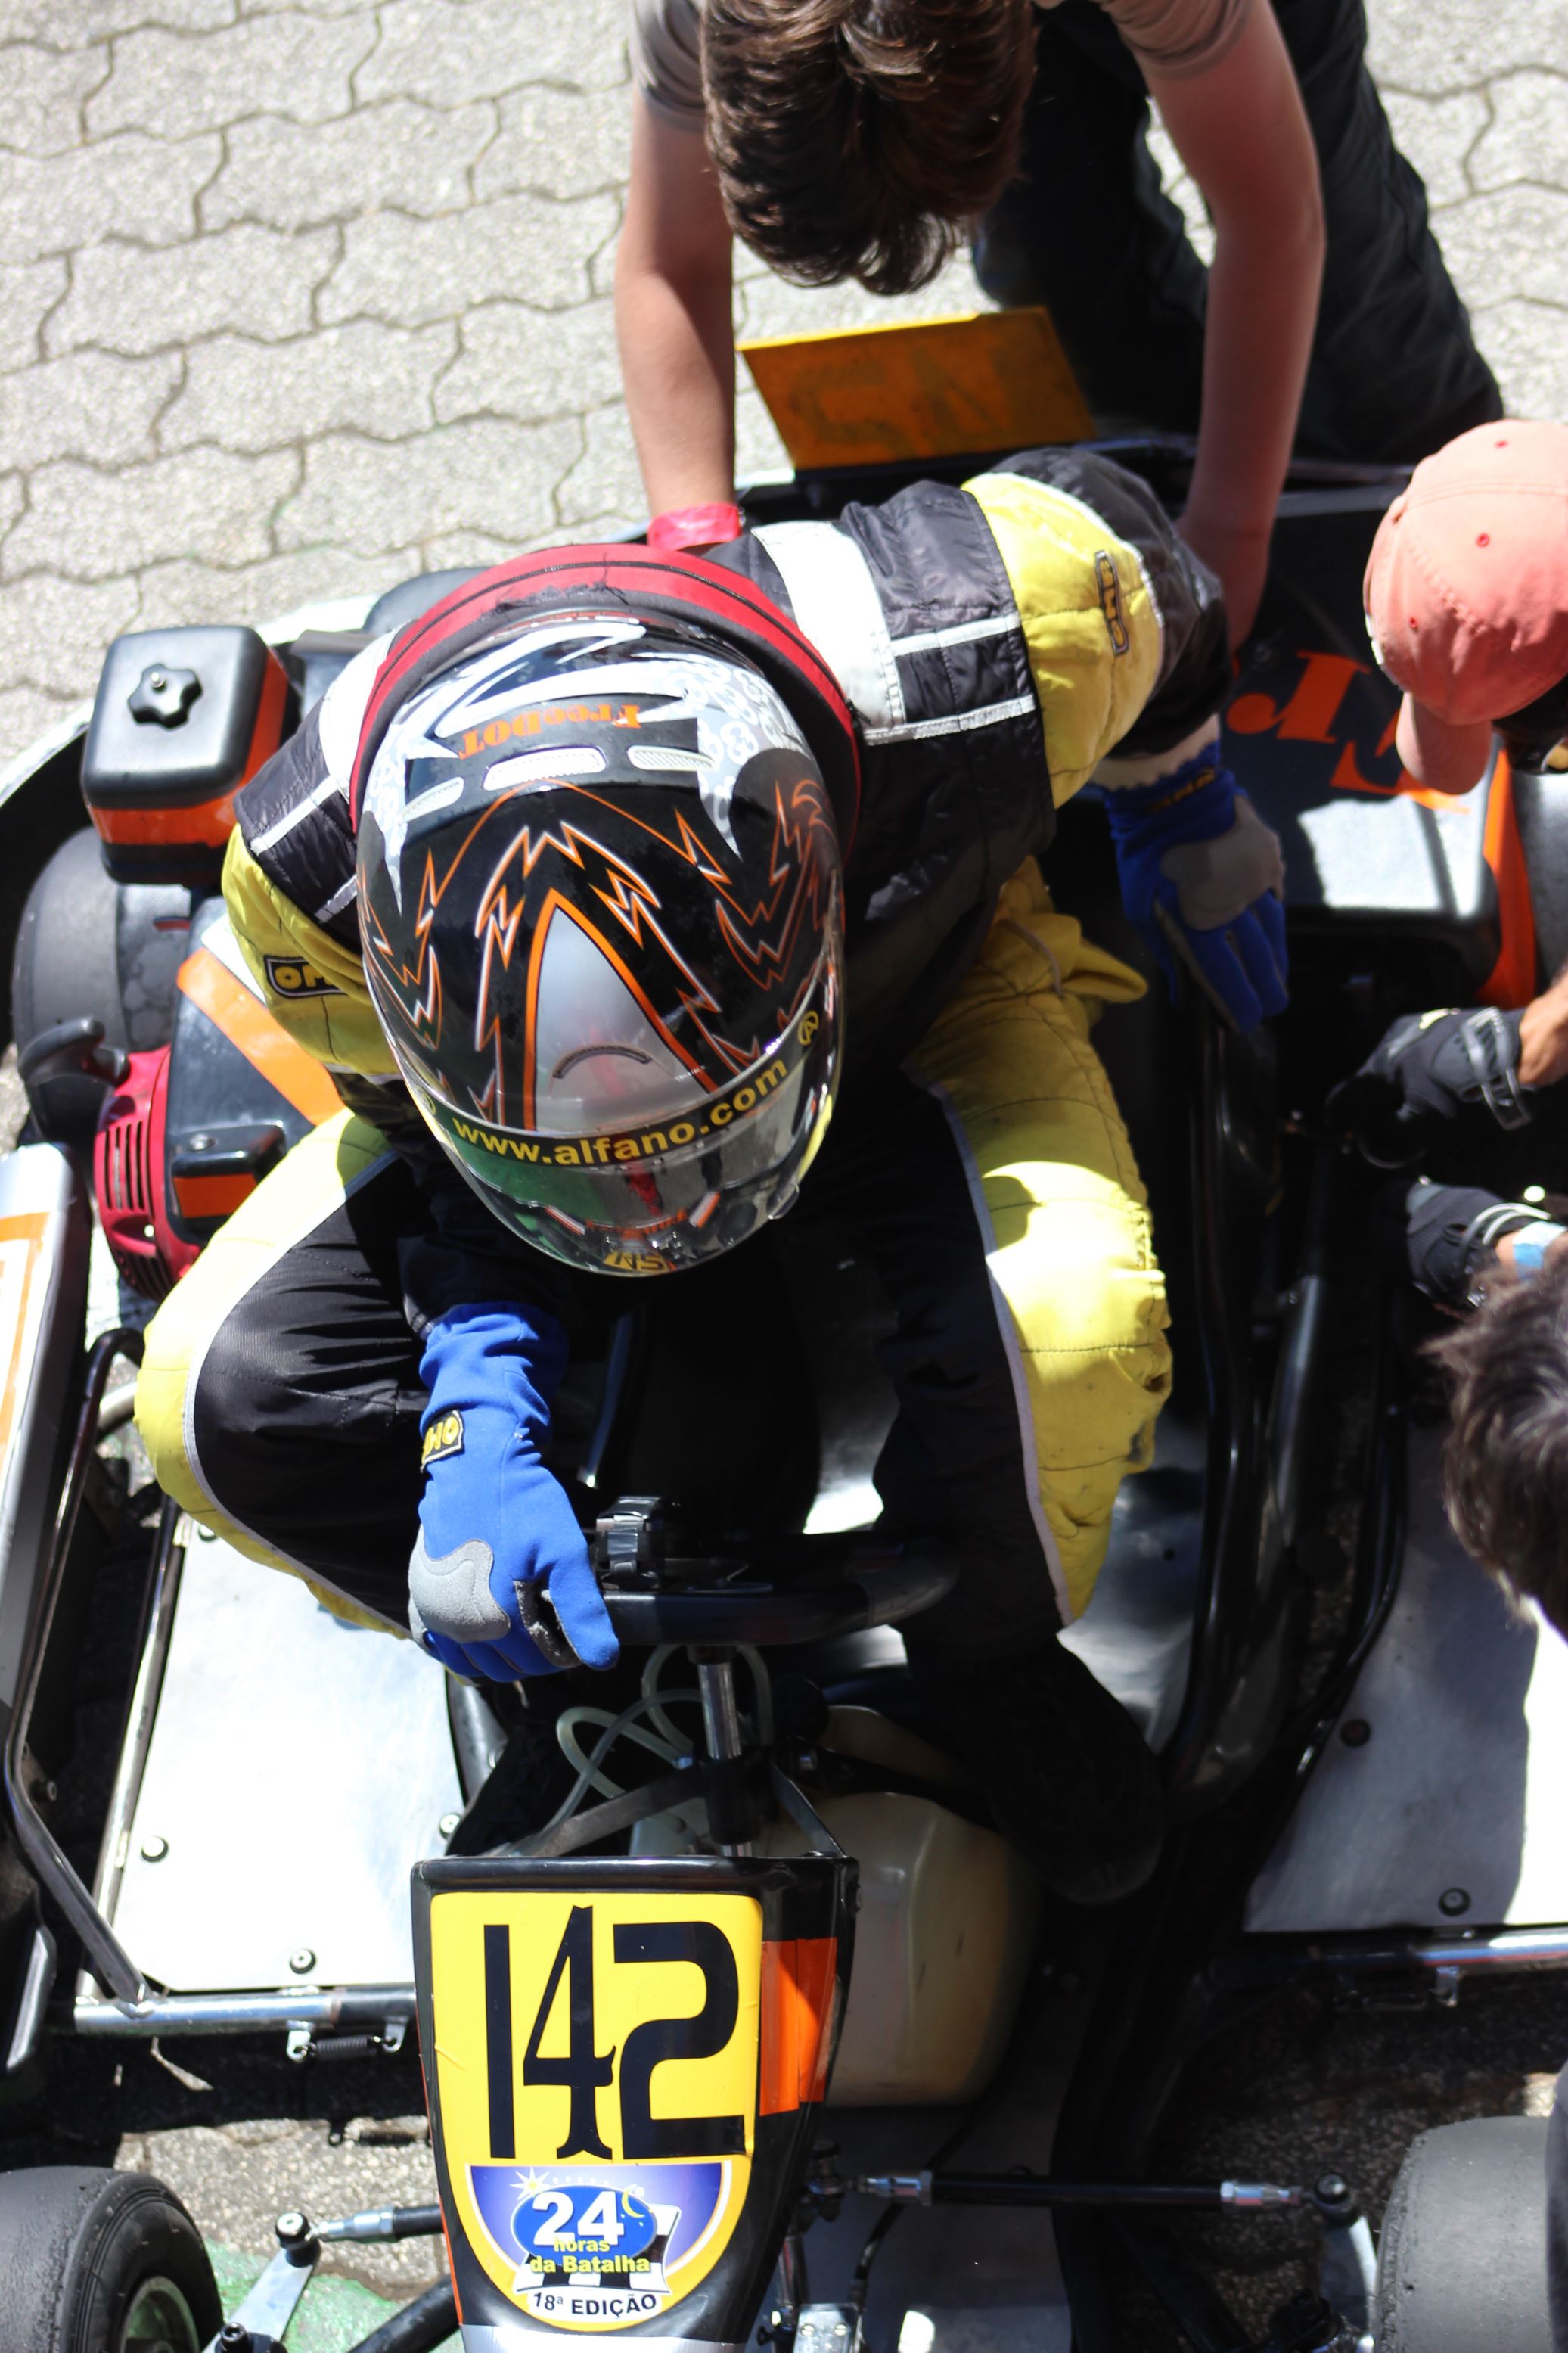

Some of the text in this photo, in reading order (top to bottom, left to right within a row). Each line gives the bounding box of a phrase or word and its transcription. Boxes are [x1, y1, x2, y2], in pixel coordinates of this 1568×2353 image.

[458, 704, 641, 760] FreeDOT
[275, 965, 334, 990] OM
[453, 1059, 787, 1165] www.alfano.com
[483, 1905, 745, 2159] 142
[532, 2191, 625, 2246] 24
[530, 2255, 650, 2273] da Batalha
[554, 2236, 610, 2252] horas
[572, 2293, 657, 2318] EDIÇÃO
